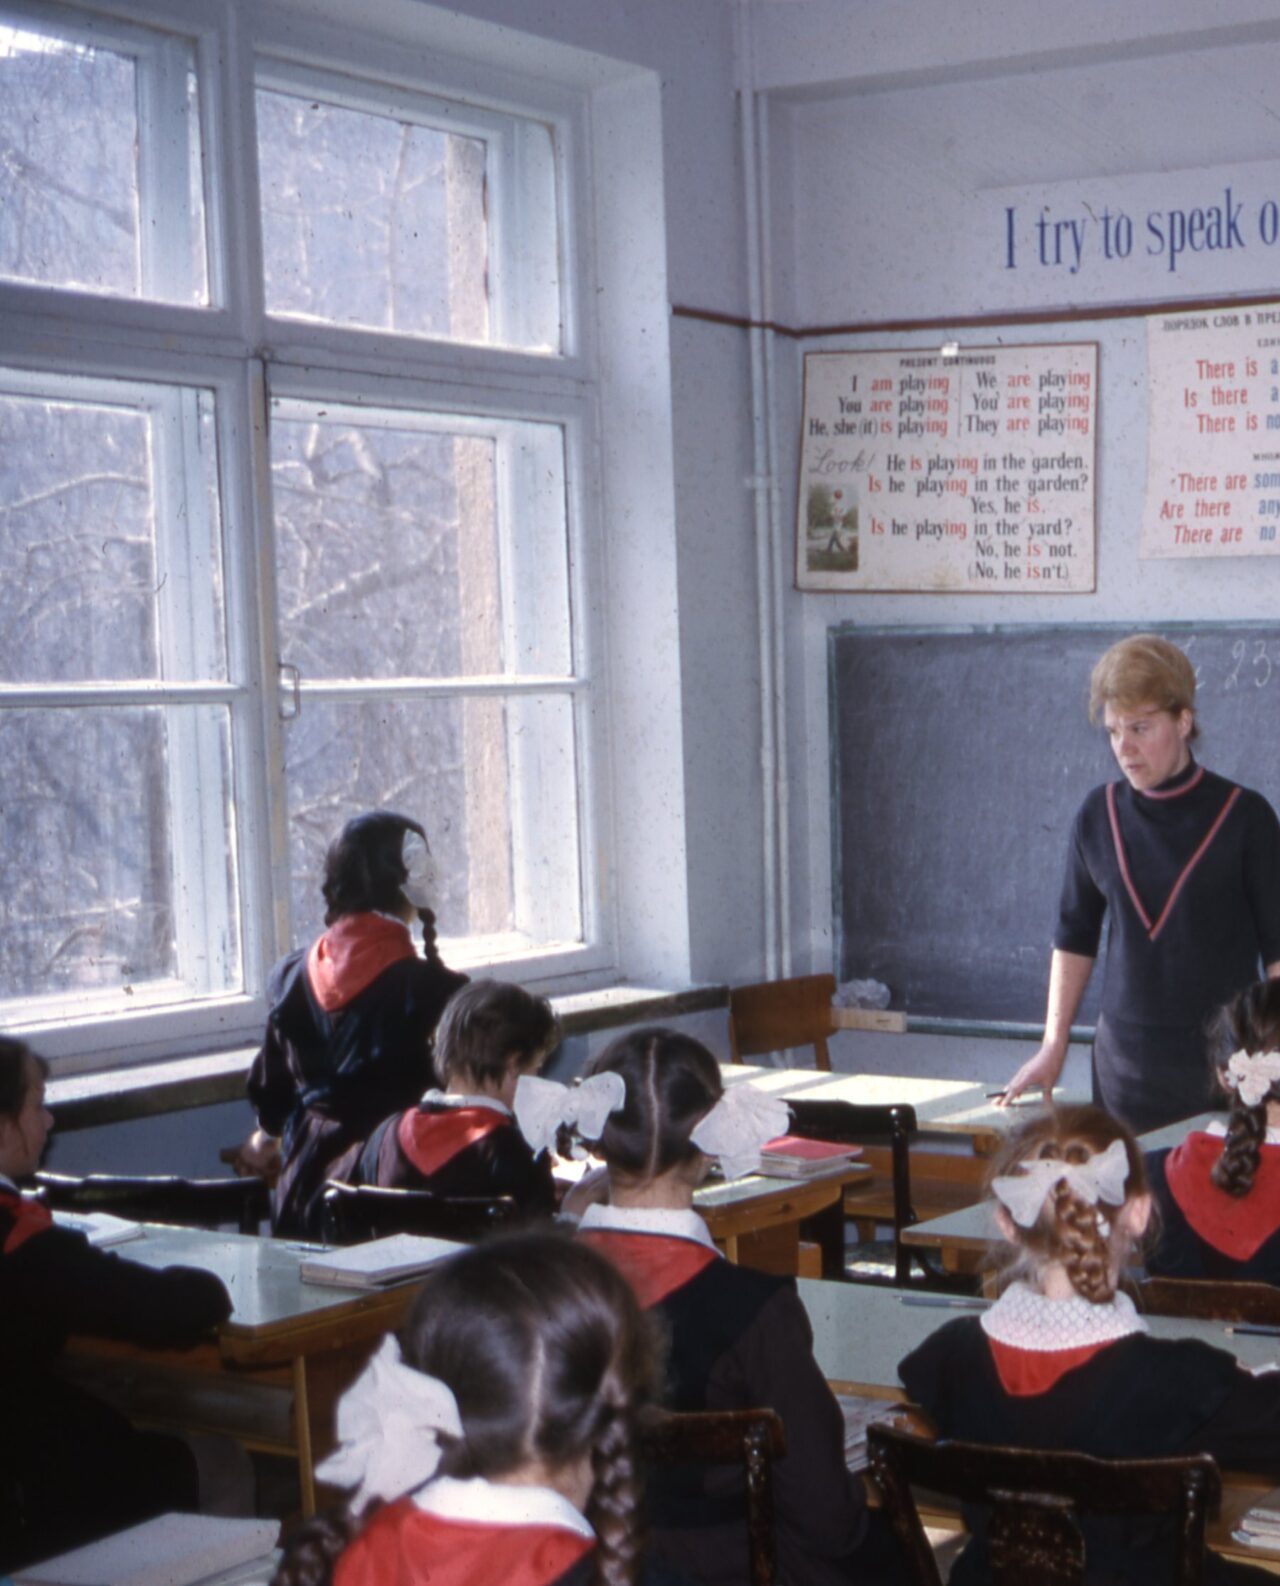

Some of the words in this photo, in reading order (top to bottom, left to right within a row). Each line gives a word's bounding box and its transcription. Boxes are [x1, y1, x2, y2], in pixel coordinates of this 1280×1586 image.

[1005, 206, 1017, 269] I
[1034, 206, 1086, 274] try
[1102, 208, 1132, 260] to
[1147, 188, 1245, 271] speak
[900, 358, 938, 367] PRESENT
[943, 355, 995, 366] CONTINUOUS
[852, 376, 857, 392] I
[871, 378, 892, 391] am
[900, 375, 949, 396] playing
[976, 372, 996, 388] We
[1007, 374, 1030, 387] are
[1039, 369, 1090, 392] playing
[1184, 388, 1197, 408] Is
[1212, 387, 1248, 406] there
[1271, 386, 1278, 402] a
[809, 419, 829, 436] He,
[833, 419, 856, 434] she
[858, 418, 878, 435] (it)
[880, 419, 892, 433] is
[898, 418, 948, 439] playing
[965, 415, 999, 436] They
[1006, 419, 1030, 431] are
[1038, 412, 1089, 436] playing
[1197, 412, 1235, 433] There
[1246, 411, 1258, 430] is
[1266, 411, 1280, 429] no
[808, 452, 875, 475] Look!
[887, 454, 905, 471] He
[910, 455, 922, 470] is
[928, 454, 978, 474] playing
[984, 454, 996, 469] in
[1002, 453, 1025, 468] the
[1032, 455, 1088, 472] garden.
[868, 476, 881, 492] Is
[889, 477, 905, 492] he
[916, 477, 967, 497] playing
[975, 477, 987, 491] in
[996, 476, 1019, 490] the
[1028, 474, 1088, 494] garden?
[971, 497, 996, 515] Yes,
[1004, 498, 1020, 513] he
[1160, 499, 1183, 521] Are
[1195, 498, 1230, 517] there
[1004, 562, 1020, 578] he
